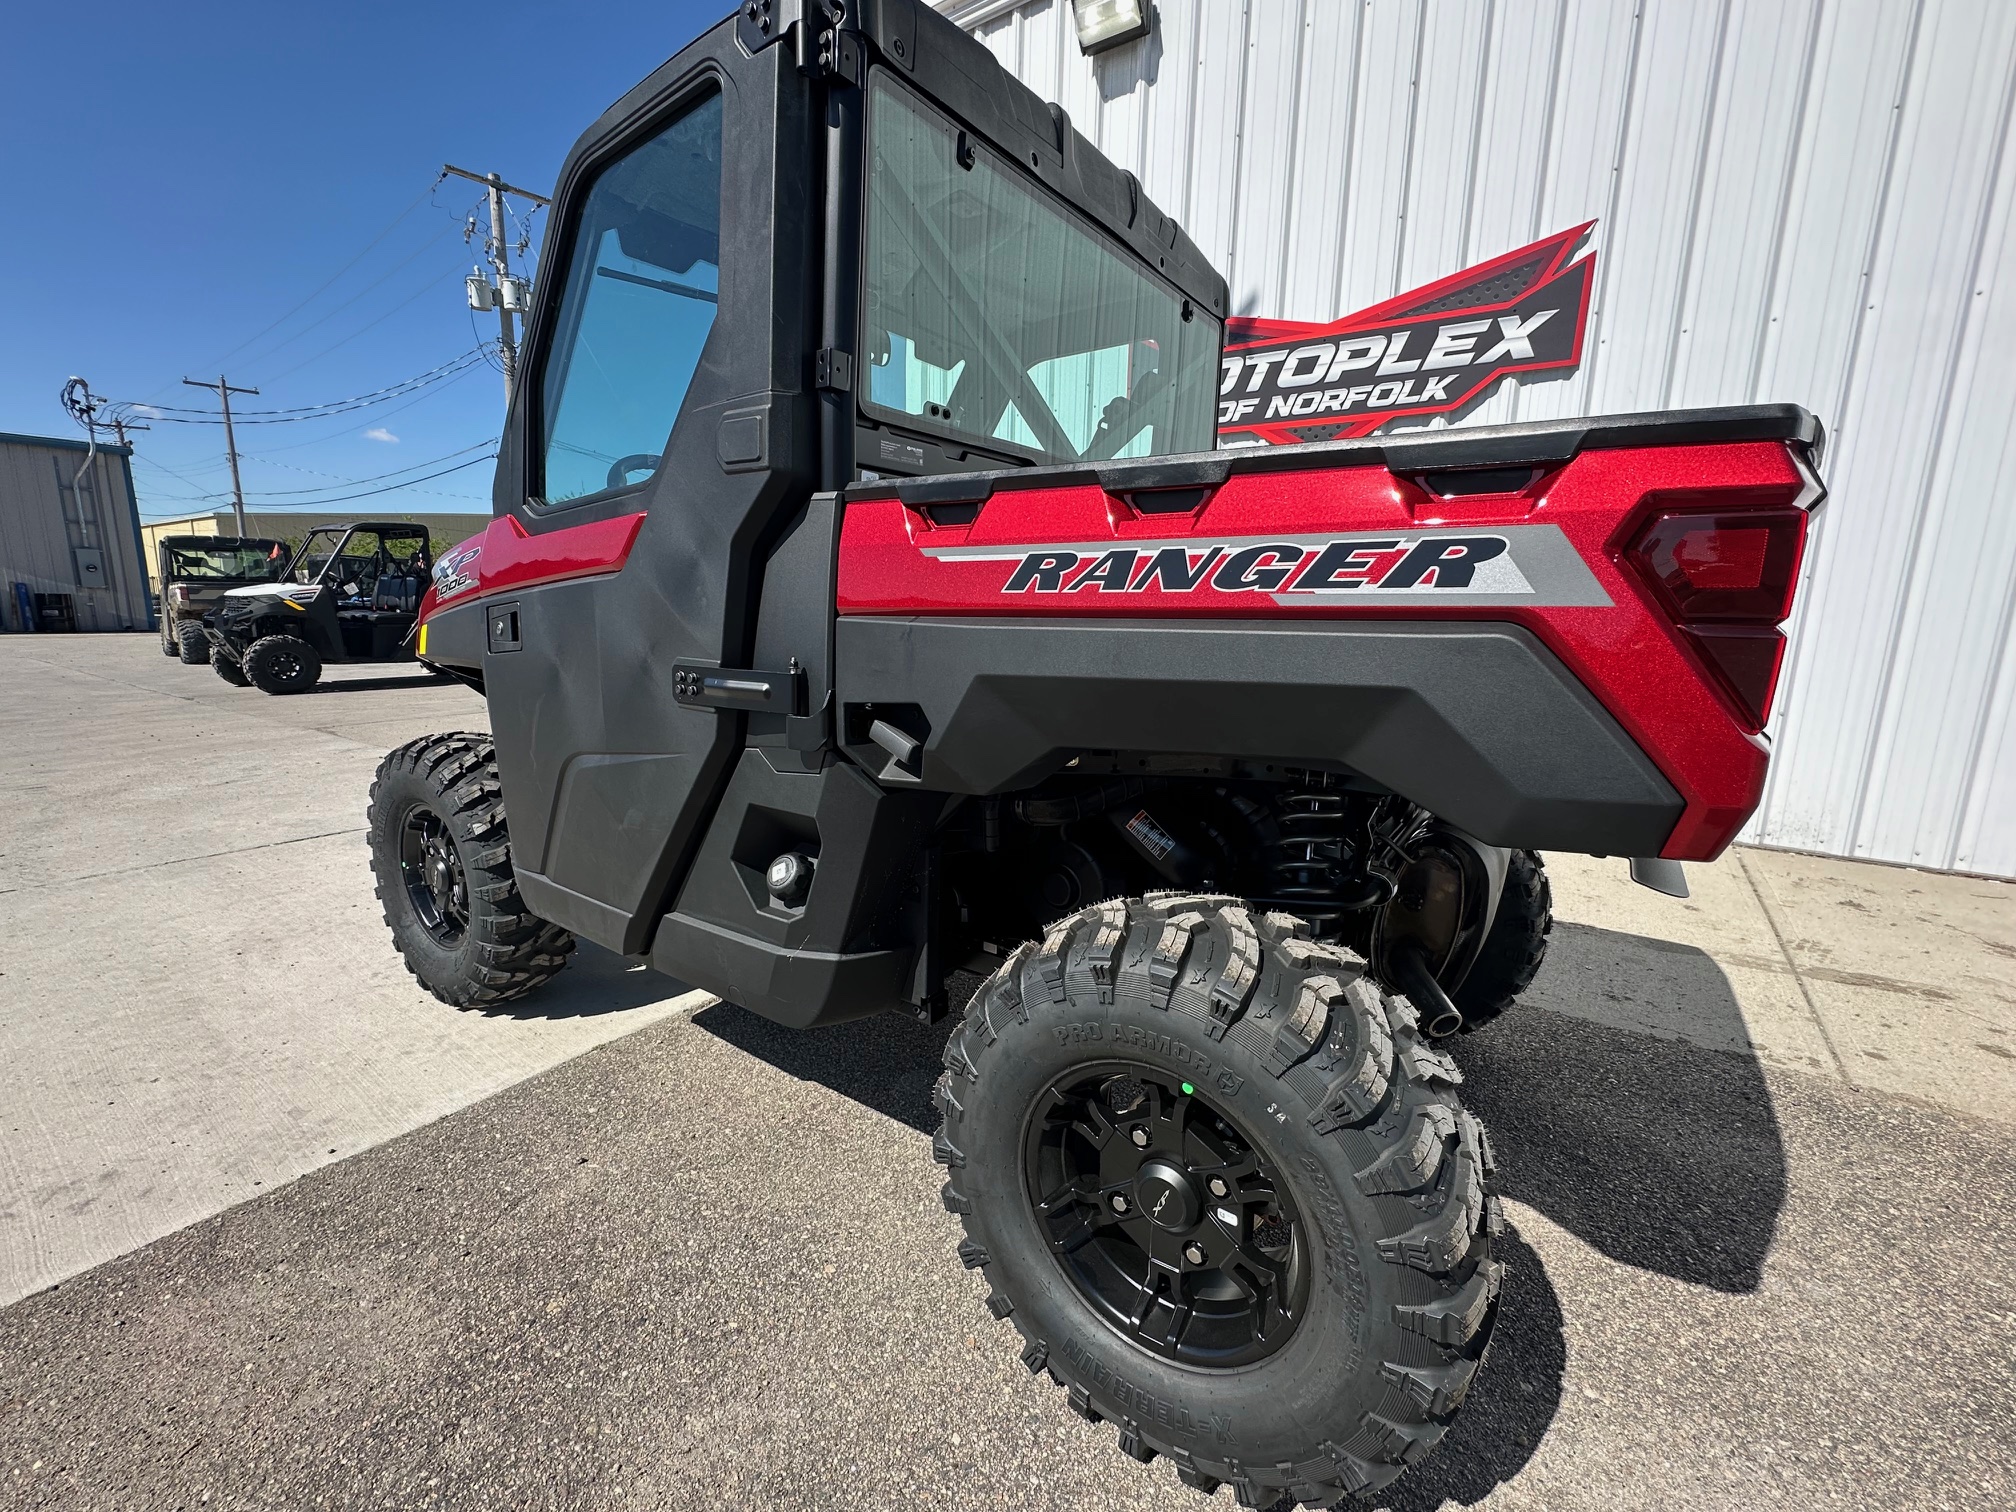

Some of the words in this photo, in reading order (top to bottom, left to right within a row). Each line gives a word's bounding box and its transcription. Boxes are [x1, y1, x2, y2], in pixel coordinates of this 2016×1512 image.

[1218, 398, 1260, 423] OF
[1264, 373, 1460, 419] NORFOLK
[433, 546, 481, 587] XP
[1002, 535, 1509, 593] RANGER
[1052, 1021, 1104, 1046] PRO
[1110, 1022, 1212, 1076] ARMOR
[1060, 1336, 1239, 1446] X-TERRAIN
